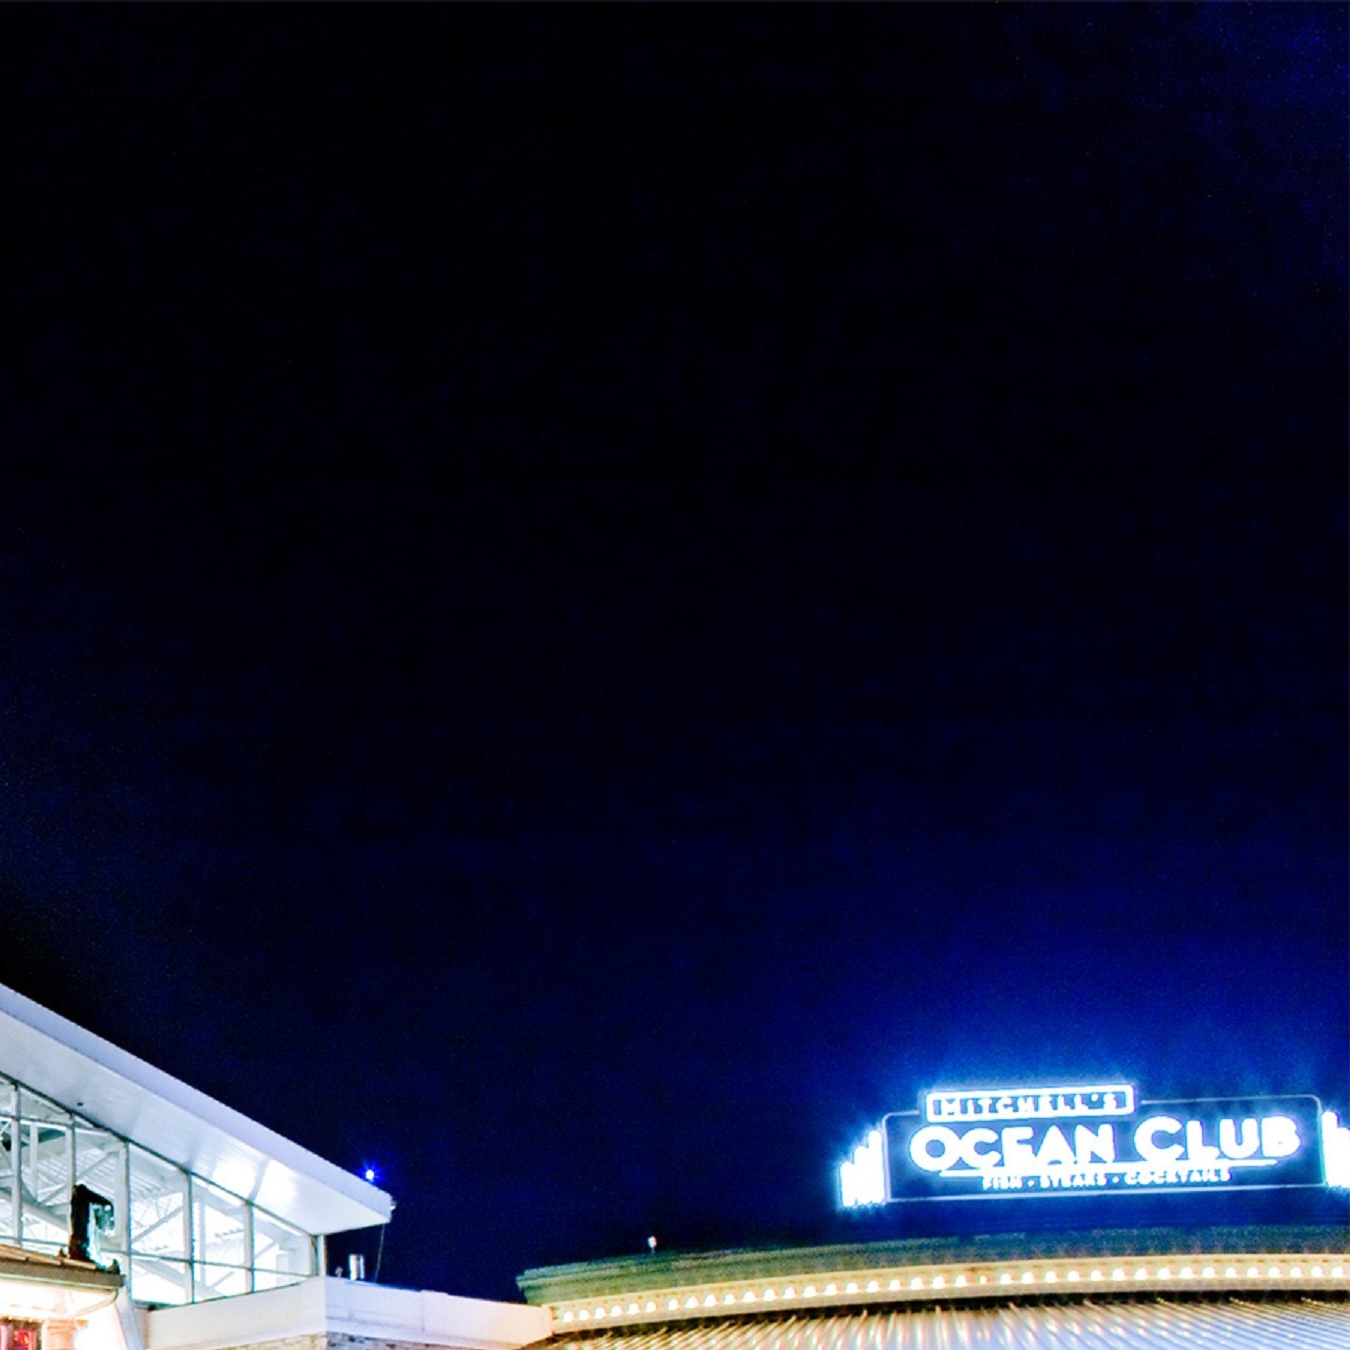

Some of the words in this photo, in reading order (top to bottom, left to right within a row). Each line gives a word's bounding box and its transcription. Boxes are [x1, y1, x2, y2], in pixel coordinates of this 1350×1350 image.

[932, 1092, 1125, 1117] MITCHELL'S
[908, 1123, 1115, 1172] OCEAN
[1133, 1115, 1301, 1162] CLUB
